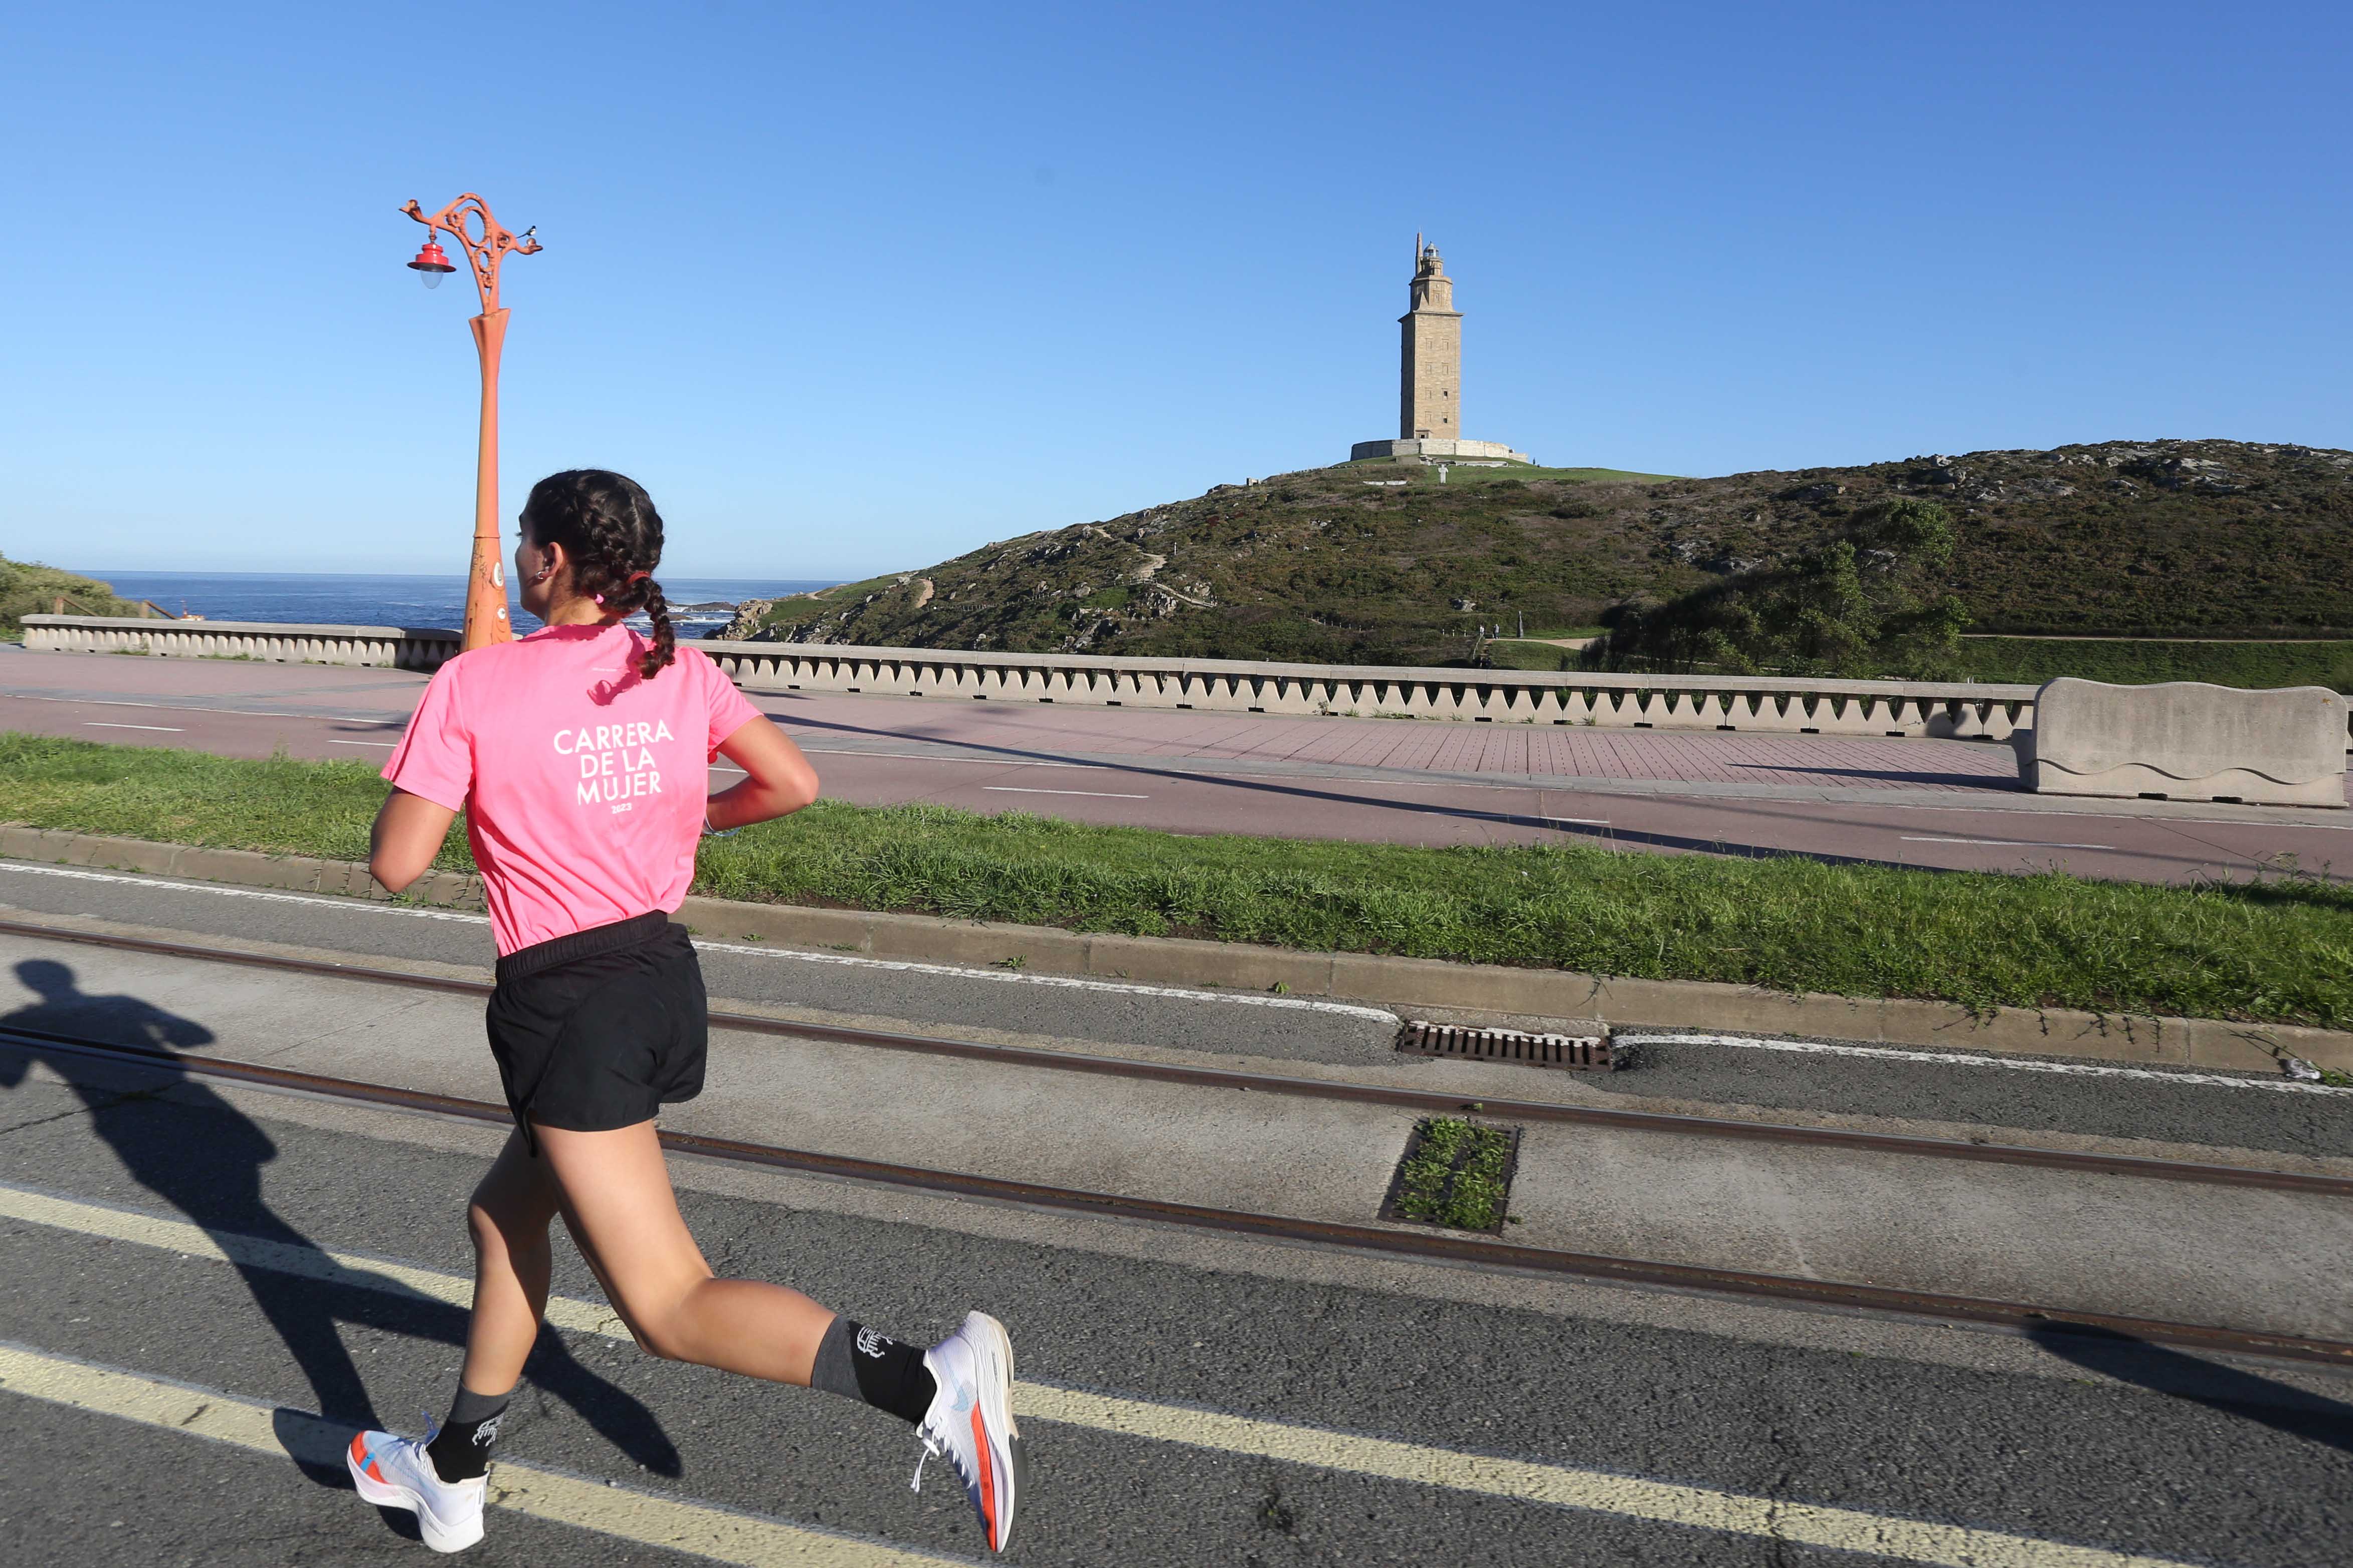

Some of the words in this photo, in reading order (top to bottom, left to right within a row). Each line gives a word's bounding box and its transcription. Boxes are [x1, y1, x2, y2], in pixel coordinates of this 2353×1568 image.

[553, 719, 674, 755] CARRERA
[580, 751, 614, 778] DE
[622, 746, 656, 772] LA
[577, 771, 662, 806] MUJER
[611, 802, 632, 814] 2023
